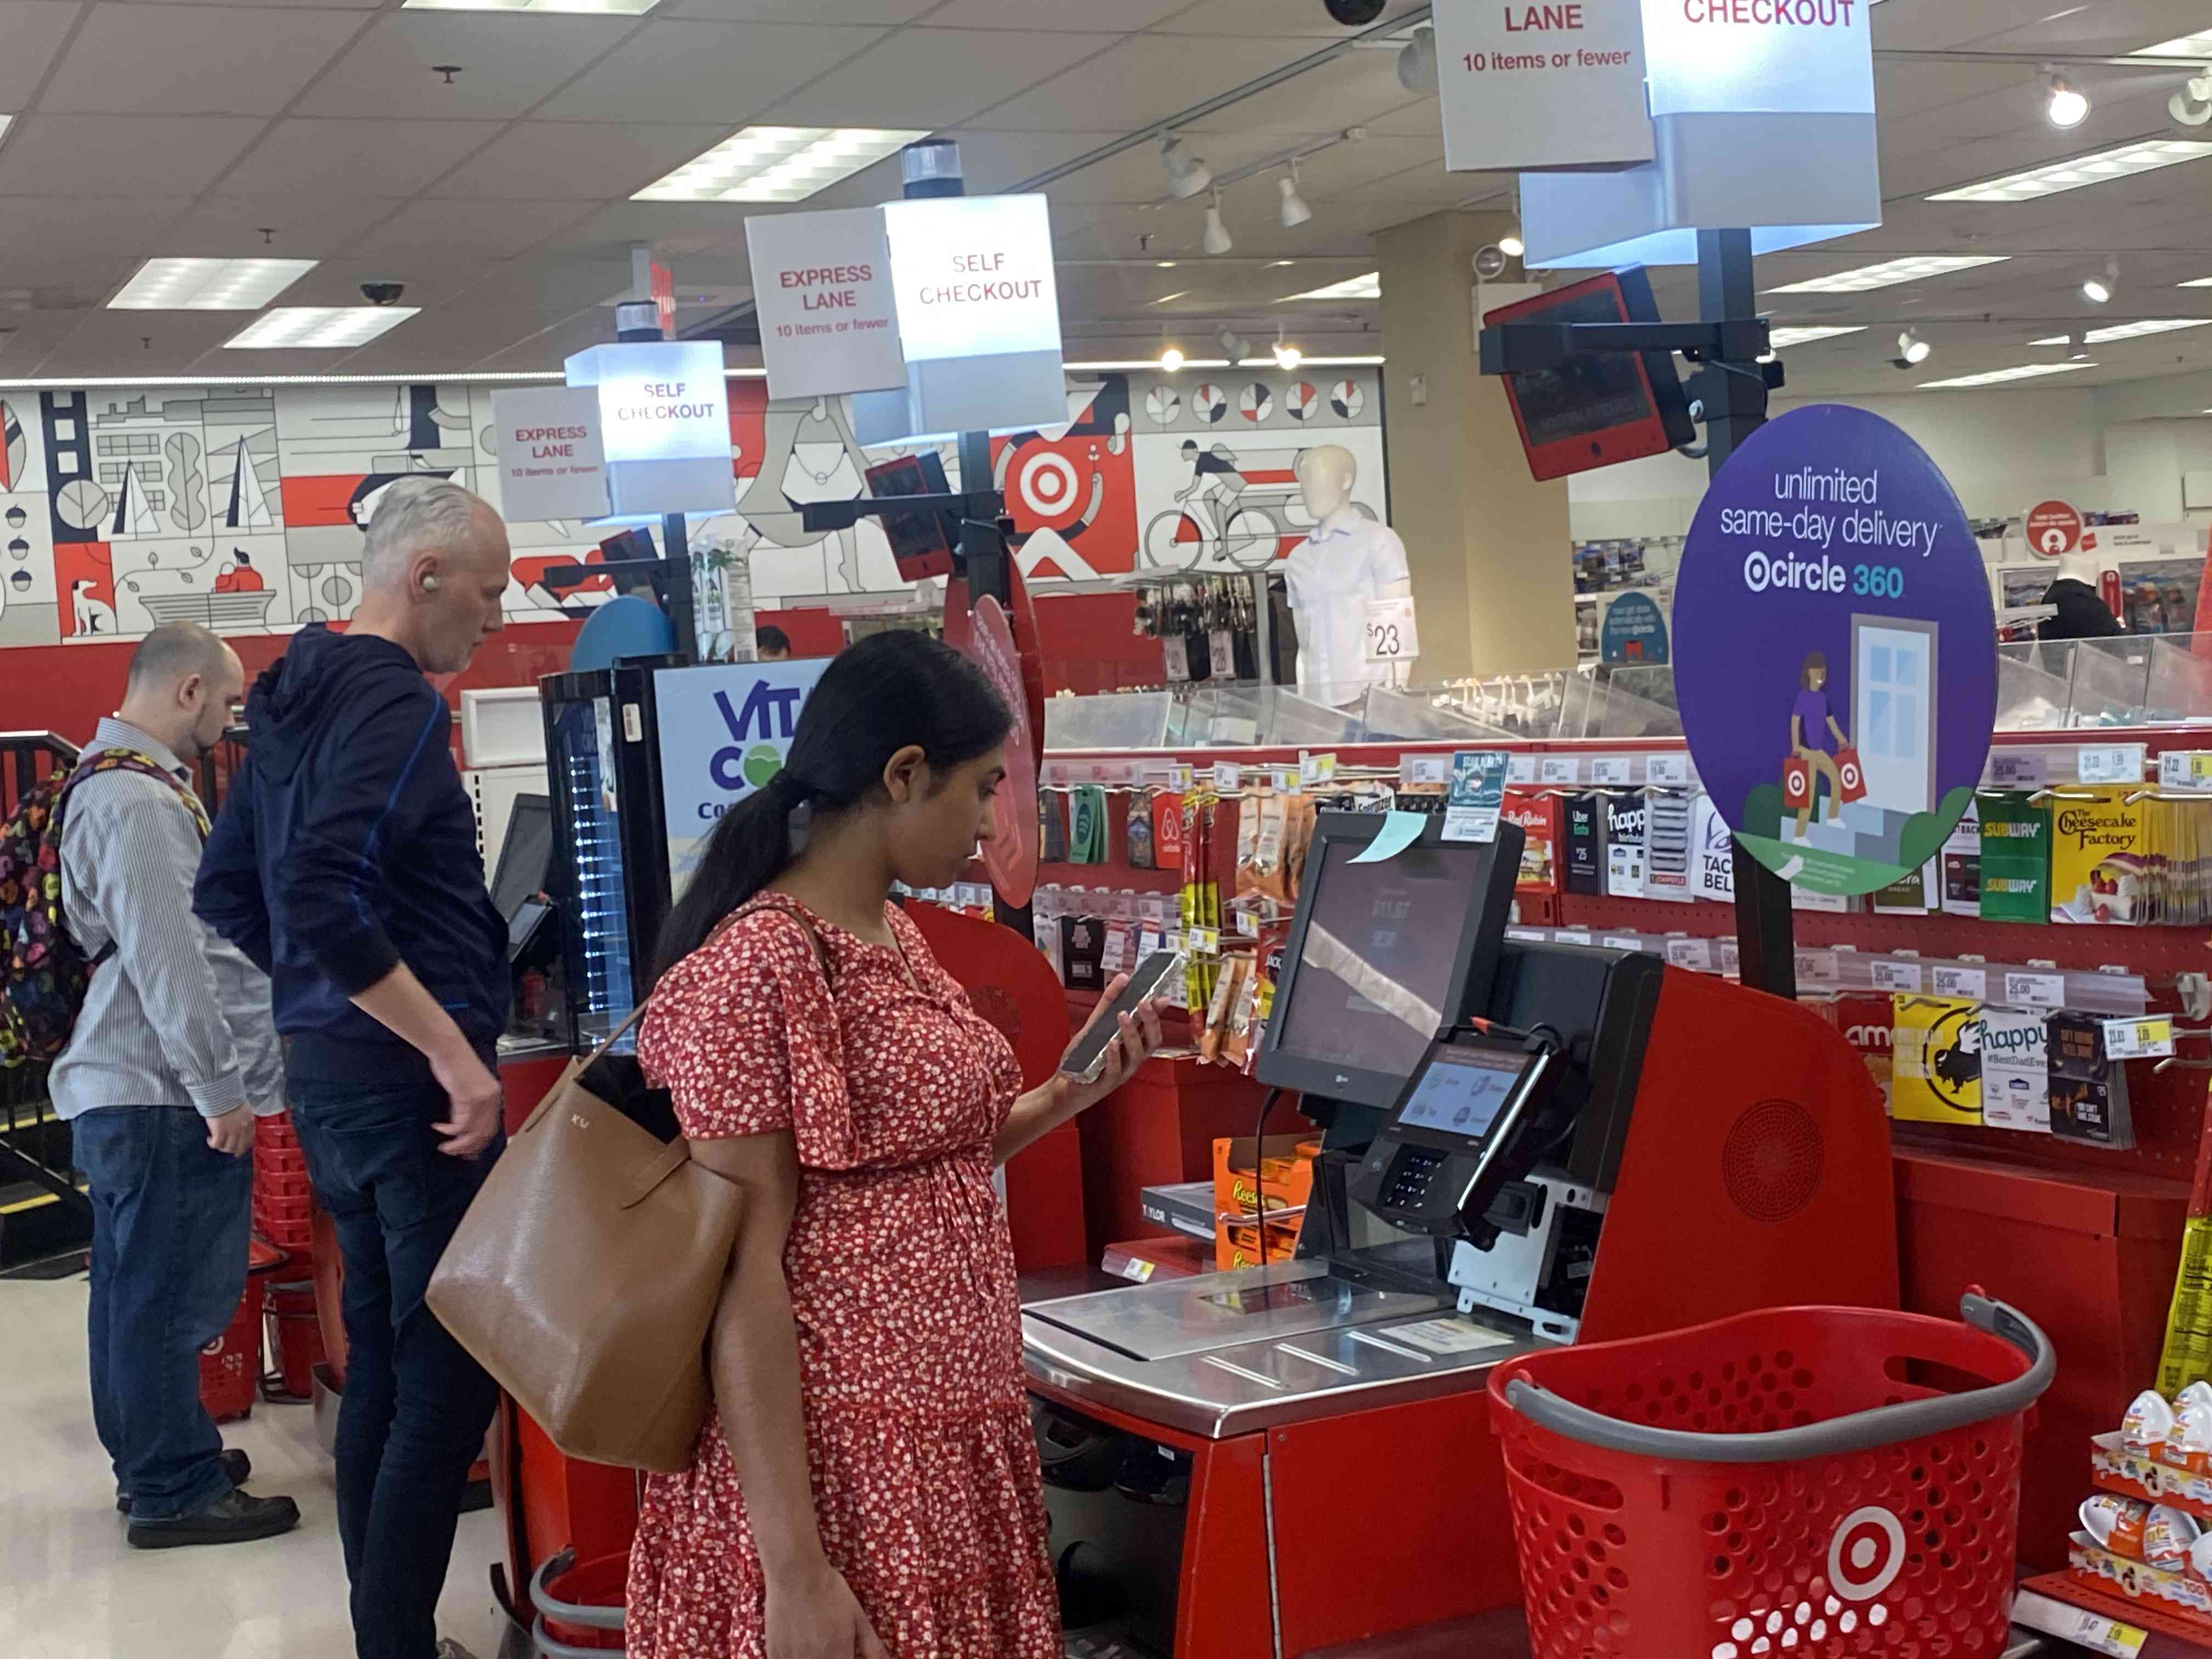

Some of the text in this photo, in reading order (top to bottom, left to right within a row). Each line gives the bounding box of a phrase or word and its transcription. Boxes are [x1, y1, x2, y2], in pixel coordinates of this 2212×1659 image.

[1504, 5, 1584, 32] LANE
[1684, 0, 1855, 27] CHECKOUT
[1463, 48, 1630, 72] 10 items or fewer
[952, 253, 1005, 273] SELF
[780, 264, 873, 289] EXPRESS
[803, 291, 857, 312] LANE
[919, 280, 1042, 304] CHECKOUT
[777, 318, 889, 337] 10 items or fewer
[644, 383, 686, 398] SELF
[618, 404, 714, 421] CHECKOUT
[515, 426, 587, 442] EXPRESS
[532, 444, 574, 459] LANE
[525, 466, 553, 476] items
[556, 466, 567, 475] or
[1774, 466, 1877, 504] unlimited
[1720, 506, 1938, 557] same-day delivery
[1770, 551, 1904, 599] circle 360
[1366, 623, 1400, 656] $23
[713, 679, 800, 742] VIT
[1607, 803, 1645, 833] happ
[2058, 810, 2137, 835] Cheesecake
[1984, 822, 2041, 838] SUBWAY
[2079, 829, 2136, 851] Factory
[1703, 854, 1733, 874] TAC
[1703, 872, 1733, 893] BEL
[1986, 878, 2036, 894] SUBWAY
[1988, 1054, 2047, 1068] #BestDadEve
